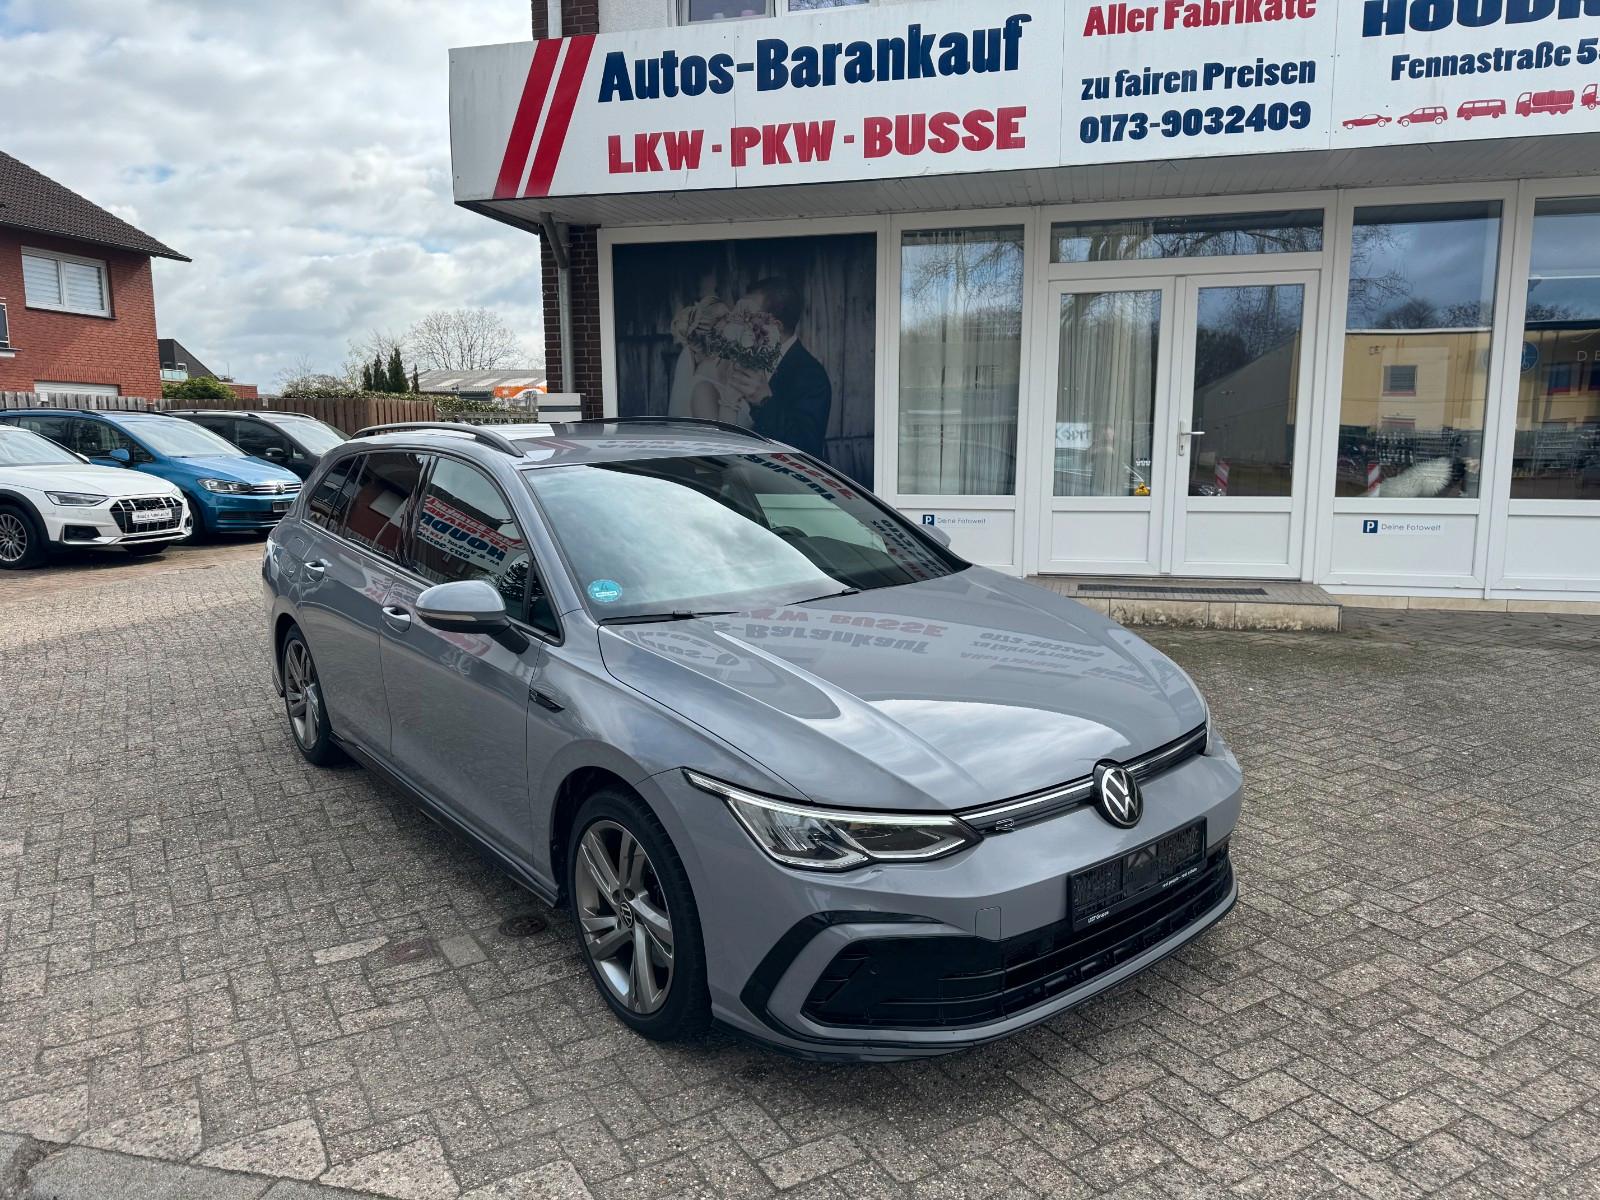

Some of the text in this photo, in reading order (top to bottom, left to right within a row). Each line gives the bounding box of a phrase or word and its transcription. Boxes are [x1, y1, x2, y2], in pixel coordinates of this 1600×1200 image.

[1082, 0, 1317, 37] Aller Fabrikate
[598, 14, 1032, 103] Autos-Barankauf
[1080, 57, 1317, 101] zu fairen Preisen
[1390, 37, 1600, 81] Fennastraße 5
[608, 129, 704, 174] LKW
[730, 119, 836, 168] PKW
[863, 105, 1026, 159] BUSSE
[1079, 100, 1312, 144] 0173-9032409
